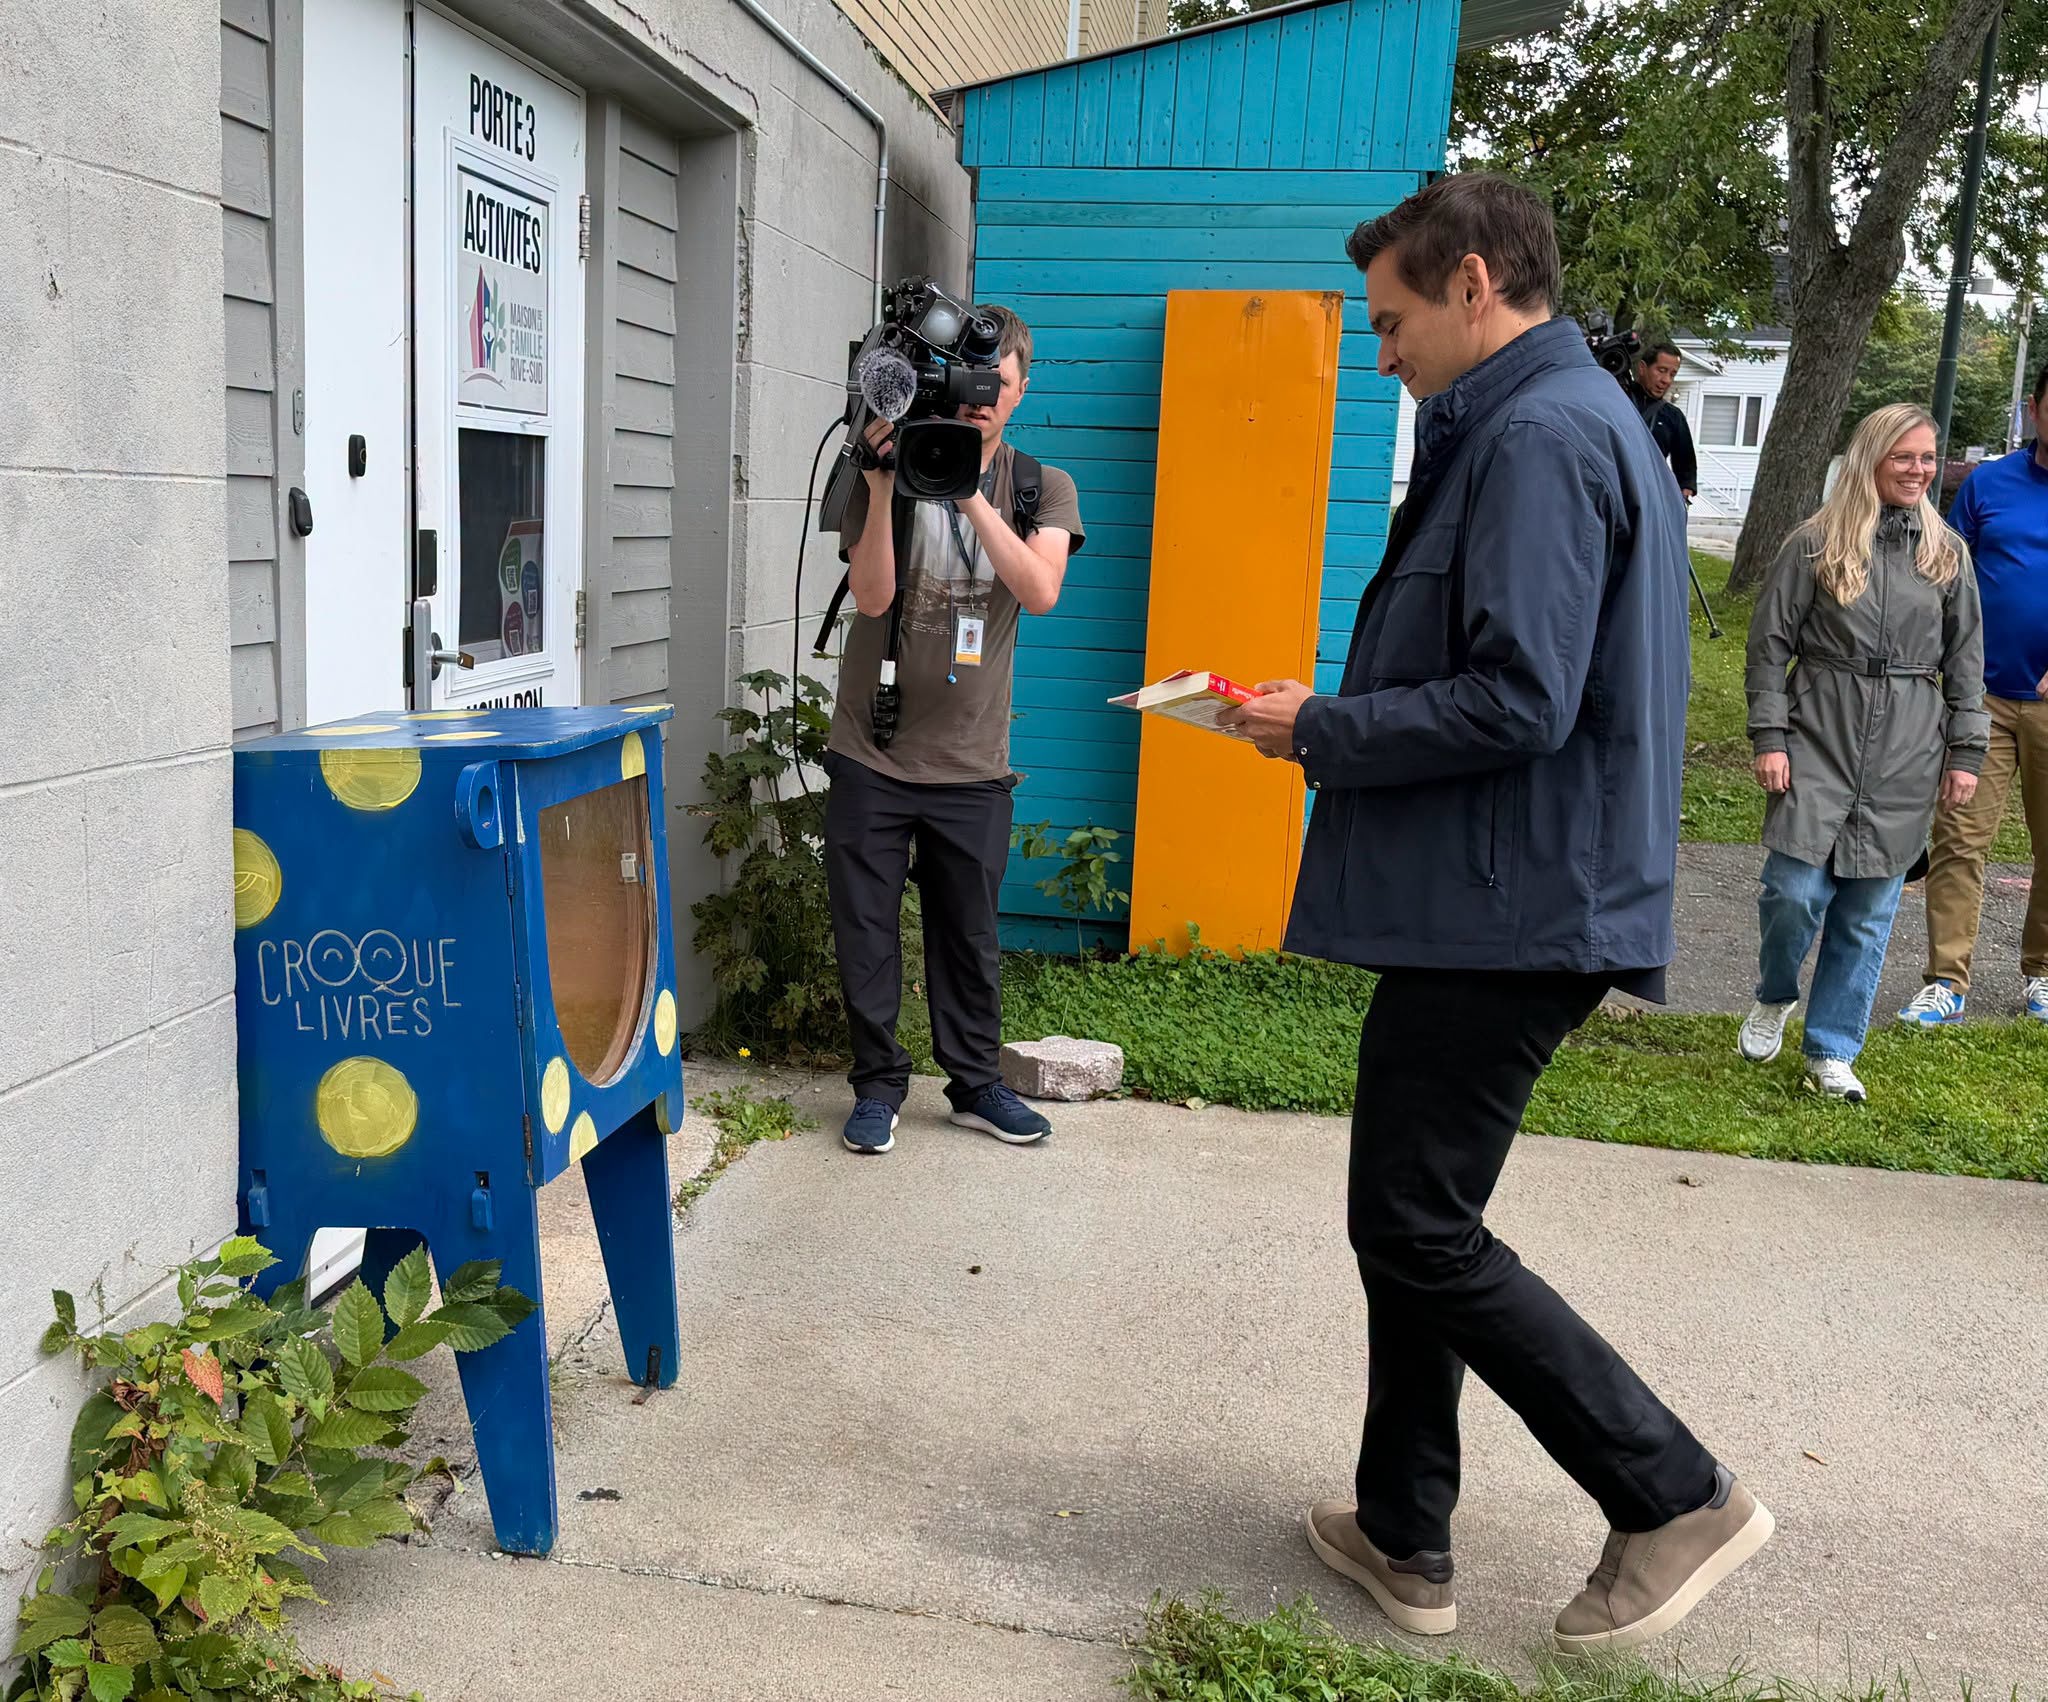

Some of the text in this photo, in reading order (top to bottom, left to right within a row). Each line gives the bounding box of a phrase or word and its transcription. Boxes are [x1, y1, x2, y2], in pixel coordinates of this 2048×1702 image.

[470, 73, 535, 162] PORTE 3
[464, 189, 541, 274] ACTIVITÉS
[510, 302, 537, 331] MAISON
[510, 328, 543, 360] FAMILLE
[510, 357, 543, 385] RIVE-SUD
[258, 929, 462, 1007] CROQUE
[296, 994, 433, 1041] LIVRES
